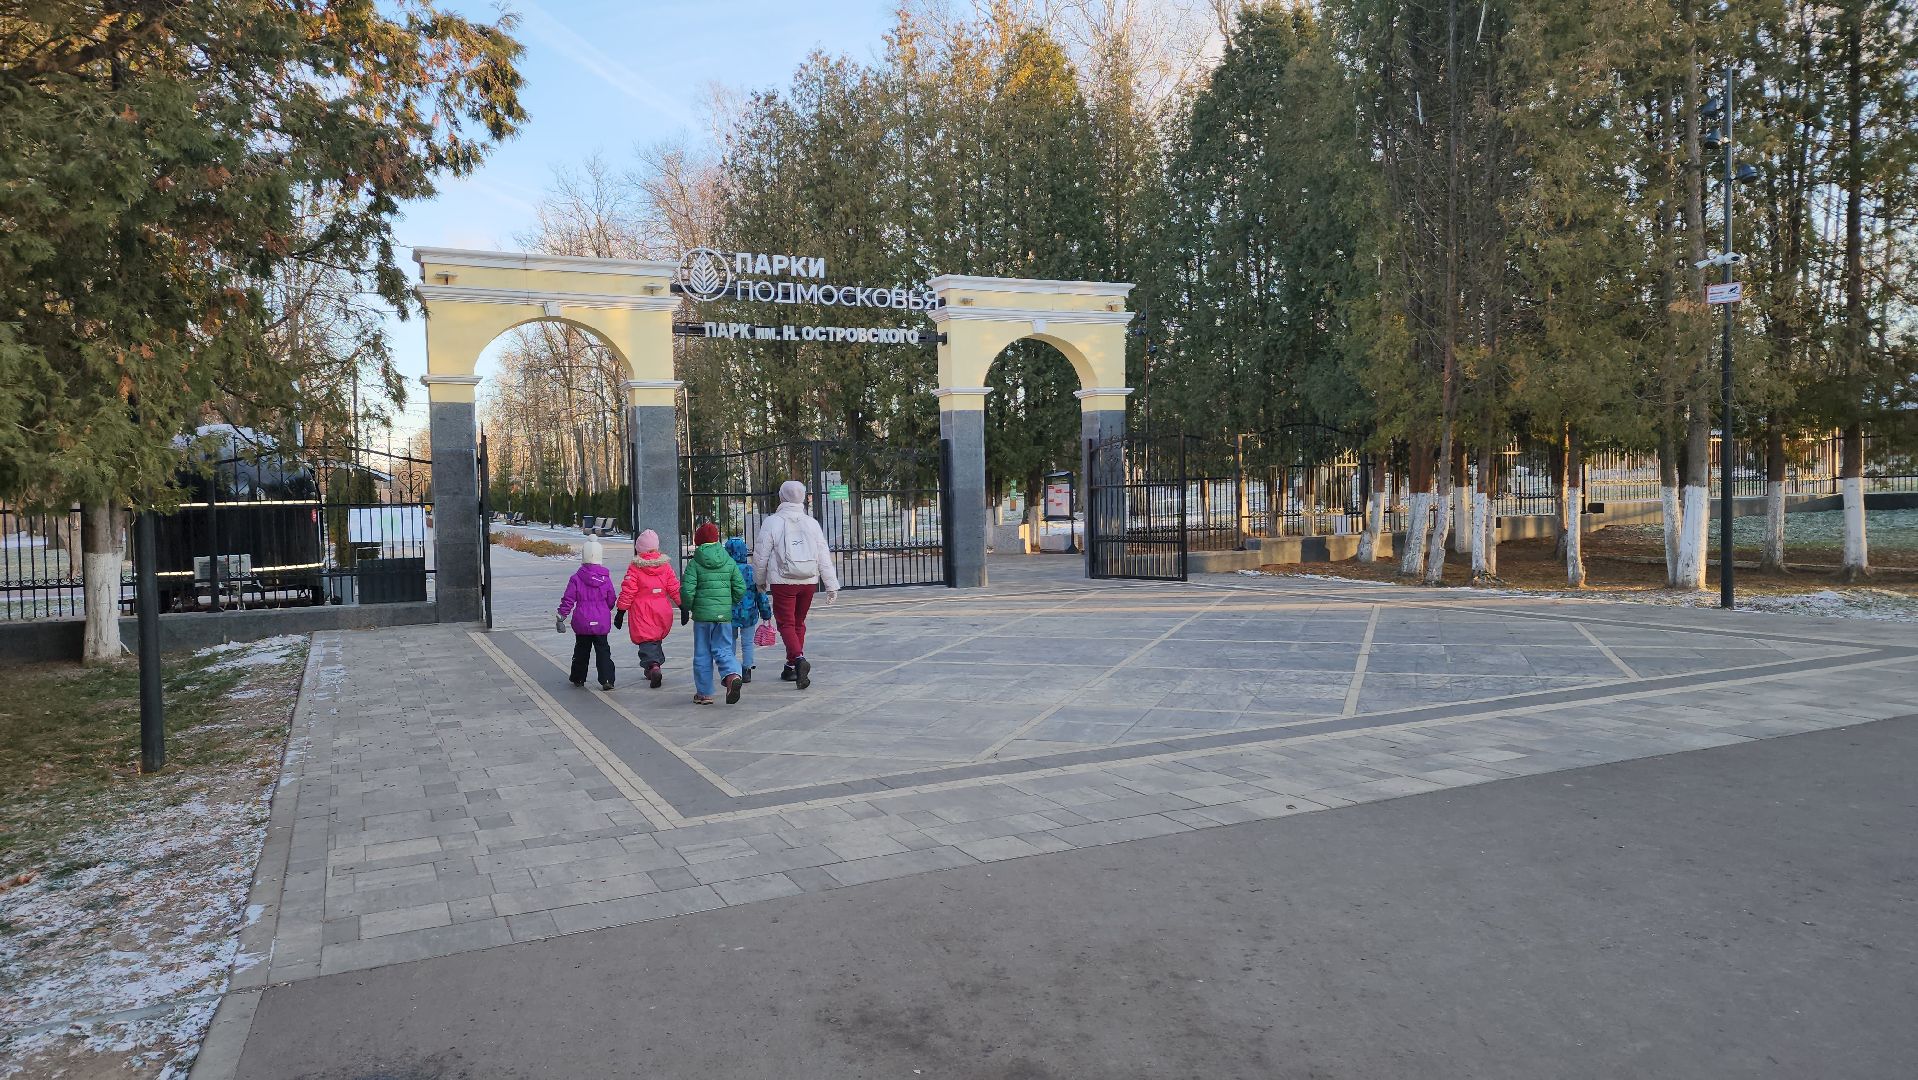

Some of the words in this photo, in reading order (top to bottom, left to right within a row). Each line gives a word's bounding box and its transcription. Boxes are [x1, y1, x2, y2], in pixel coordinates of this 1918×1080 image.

[735, 252, 825, 279] ПАРКИ
[736, 280, 940, 311] ПОДМОСКОВЬЯ
[704, 322, 751, 340] ПАРК
[801, 325, 919, 345] ОСТРОВСКОГО
